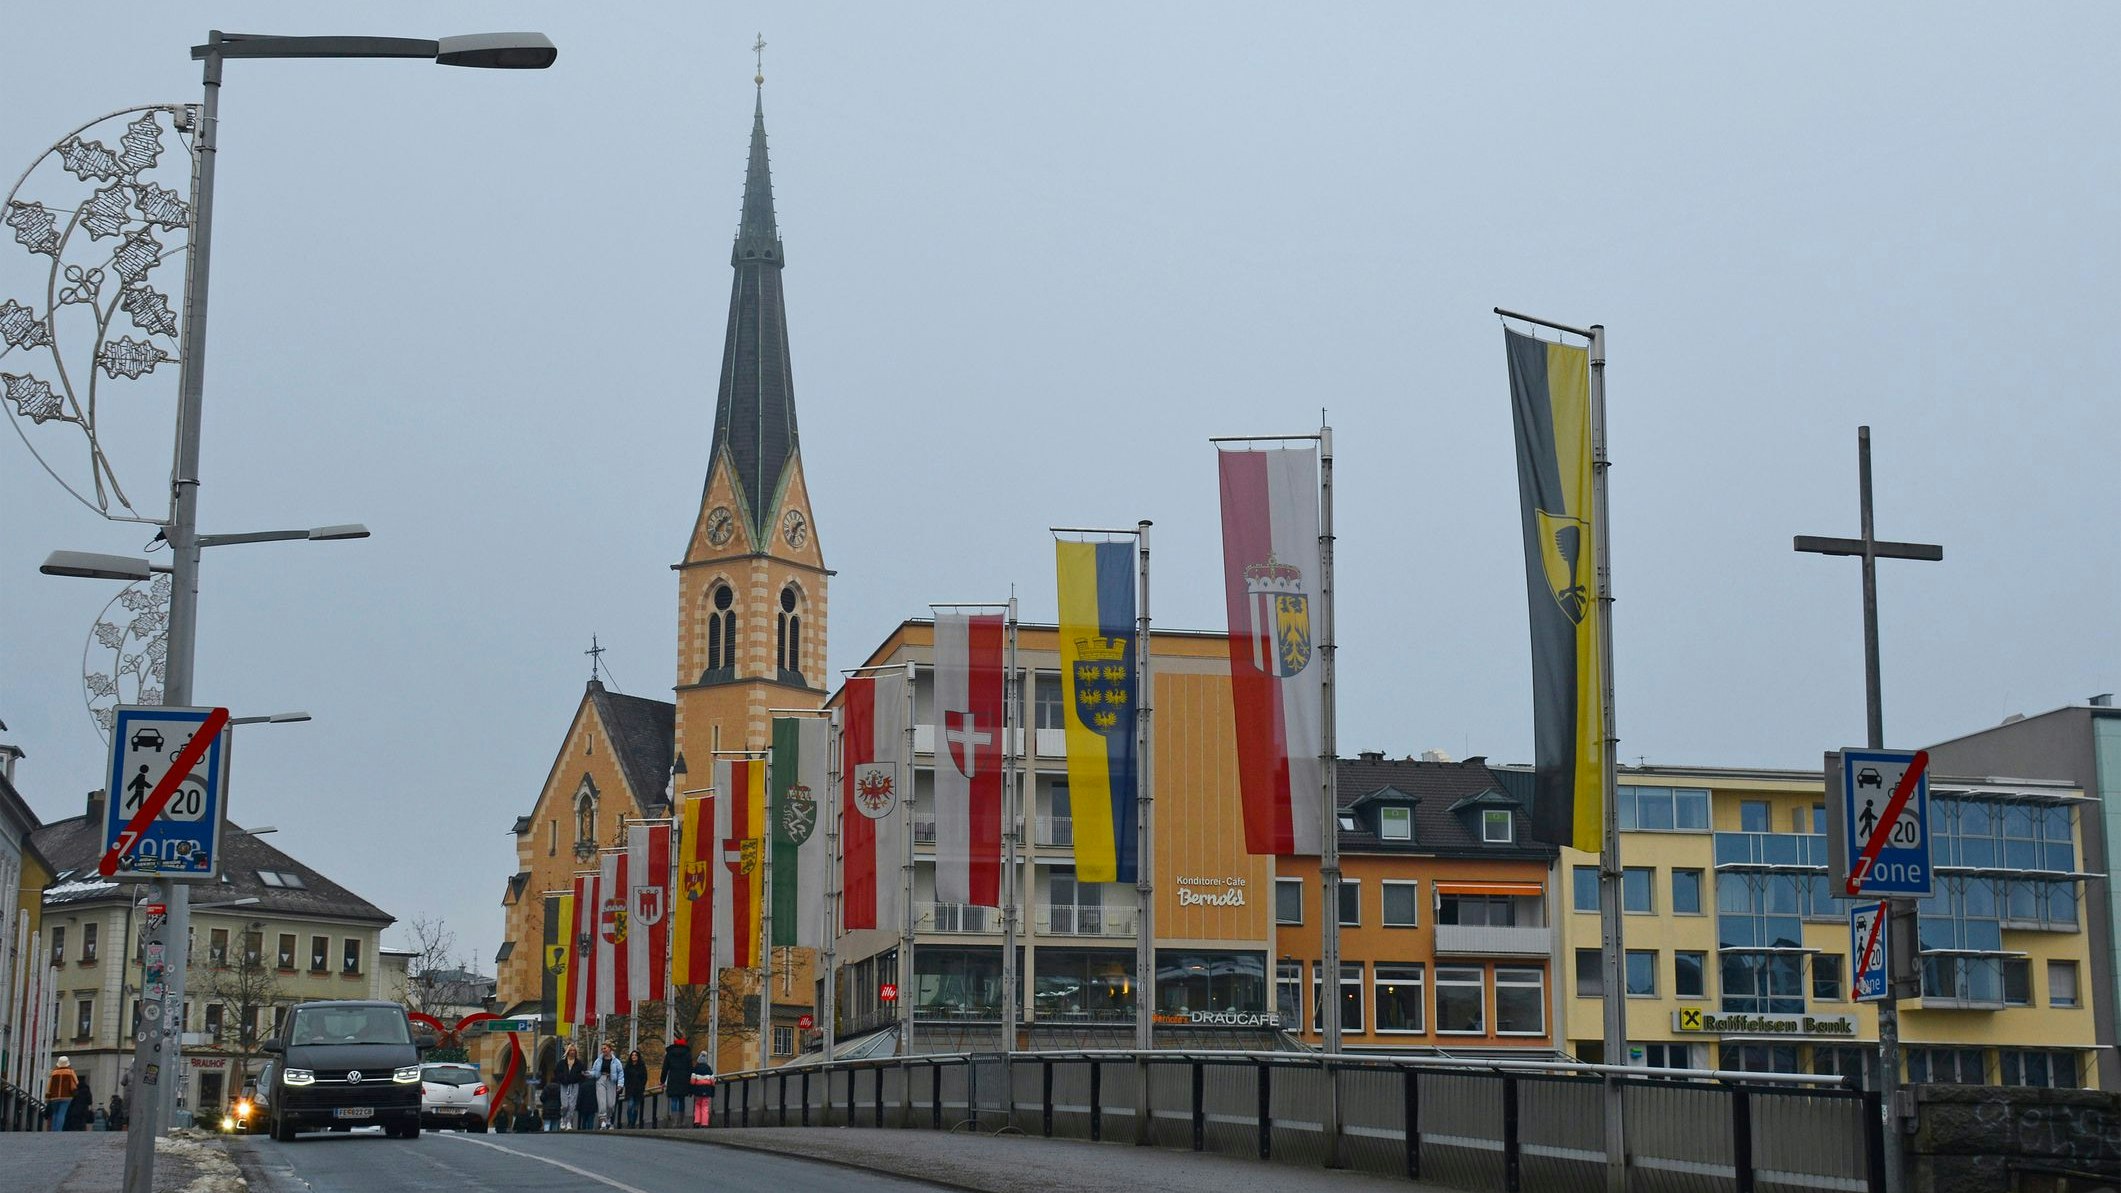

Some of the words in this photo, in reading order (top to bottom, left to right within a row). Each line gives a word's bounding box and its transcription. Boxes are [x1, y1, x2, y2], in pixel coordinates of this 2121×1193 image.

[170, 789, 201, 815] 20
[1894, 821, 1915, 843] 20
[1858, 856, 1921, 884] Zone
[1176, 887, 1246, 907] Bernold
[1871, 949, 1881, 966] 20
[881, 986, 896, 999] illy
[800, 1017, 813, 1028] illy
[1703, 1015, 1798, 1032] Raiffeisen
[1803, 1016, 1852, 1034] Bank
[191, 1058, 226, 1069] BRAUHOF
